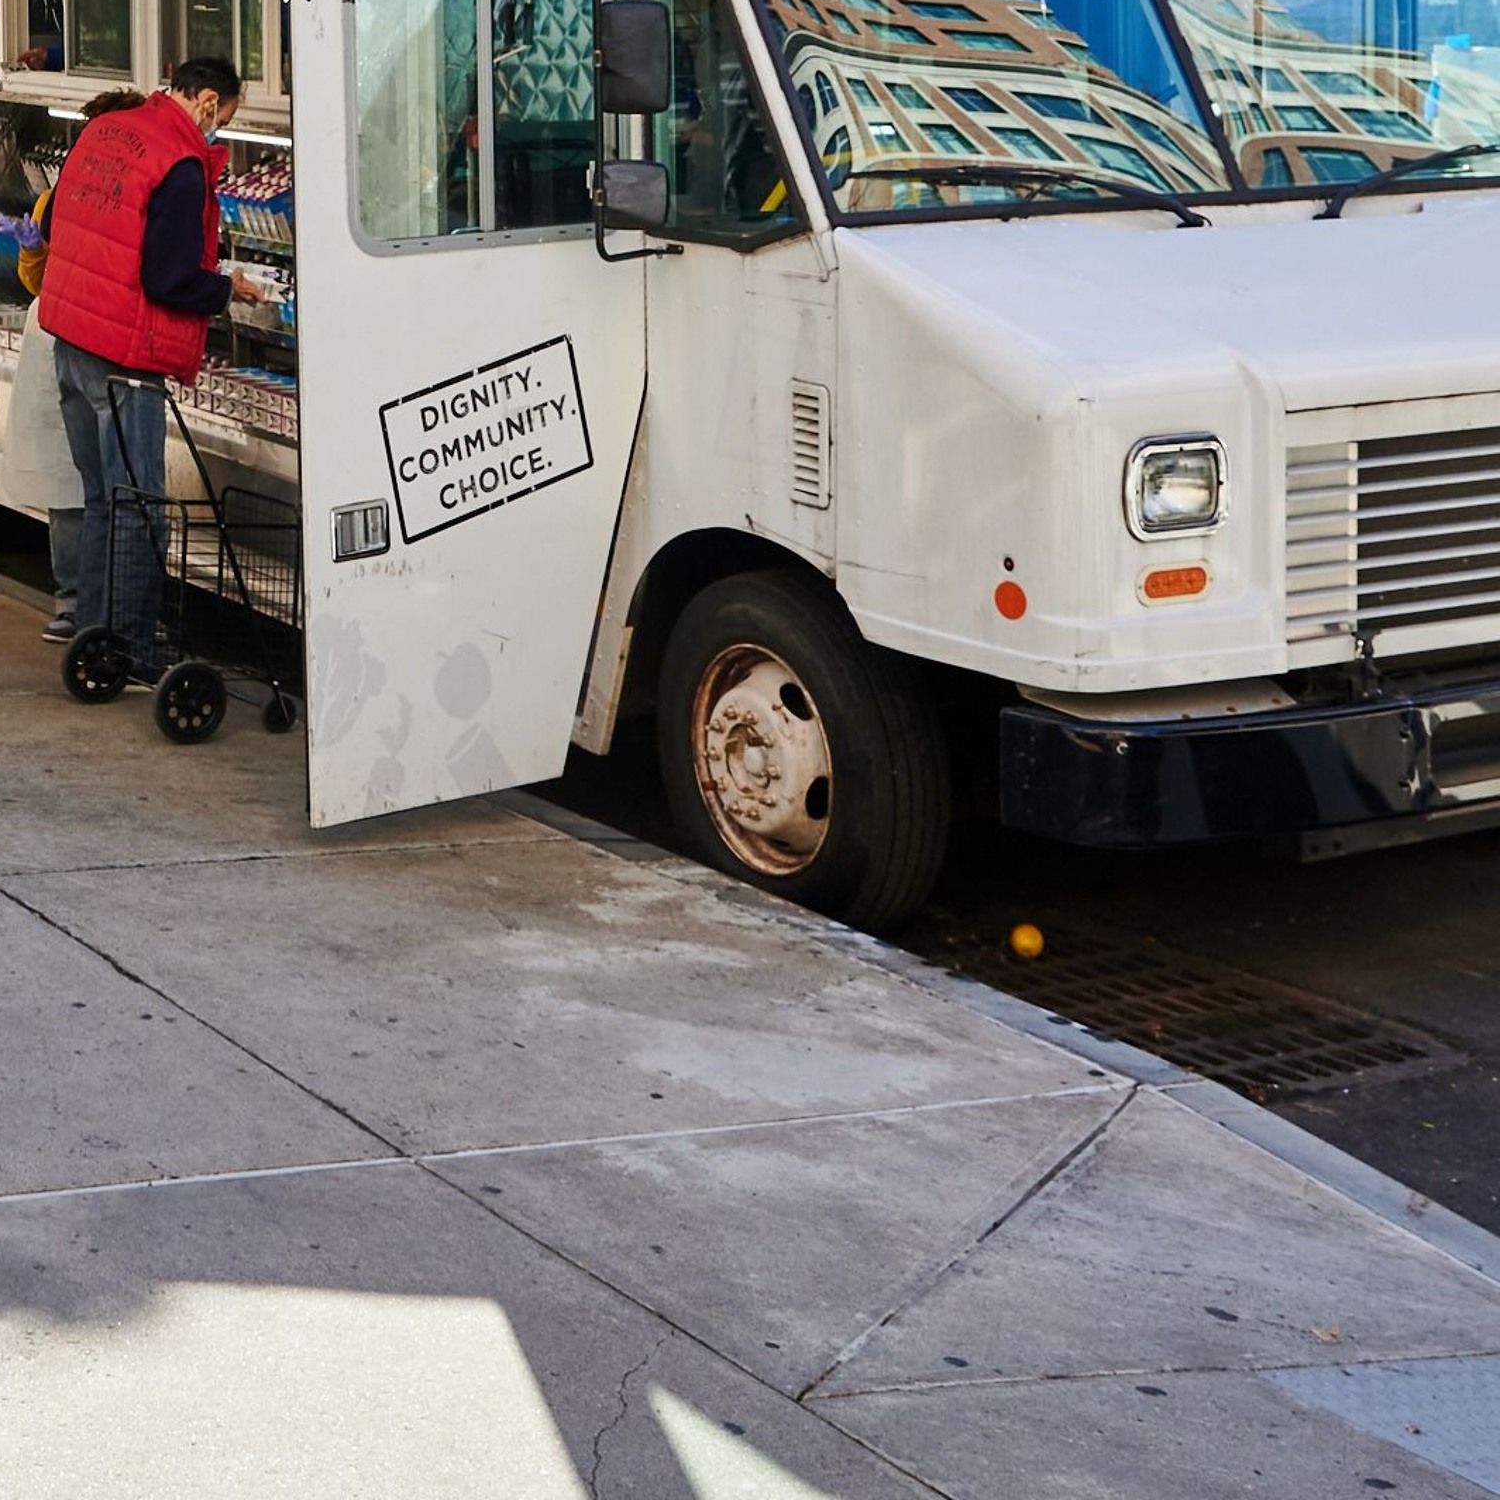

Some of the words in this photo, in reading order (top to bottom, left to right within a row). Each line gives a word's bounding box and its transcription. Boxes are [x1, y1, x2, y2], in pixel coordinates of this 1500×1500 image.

[420, 367, 542, 432] DIGNITY.
[399, 394, 576, 483] COMMUNITY.
[439, 447, 553, 510] CHOICE.
